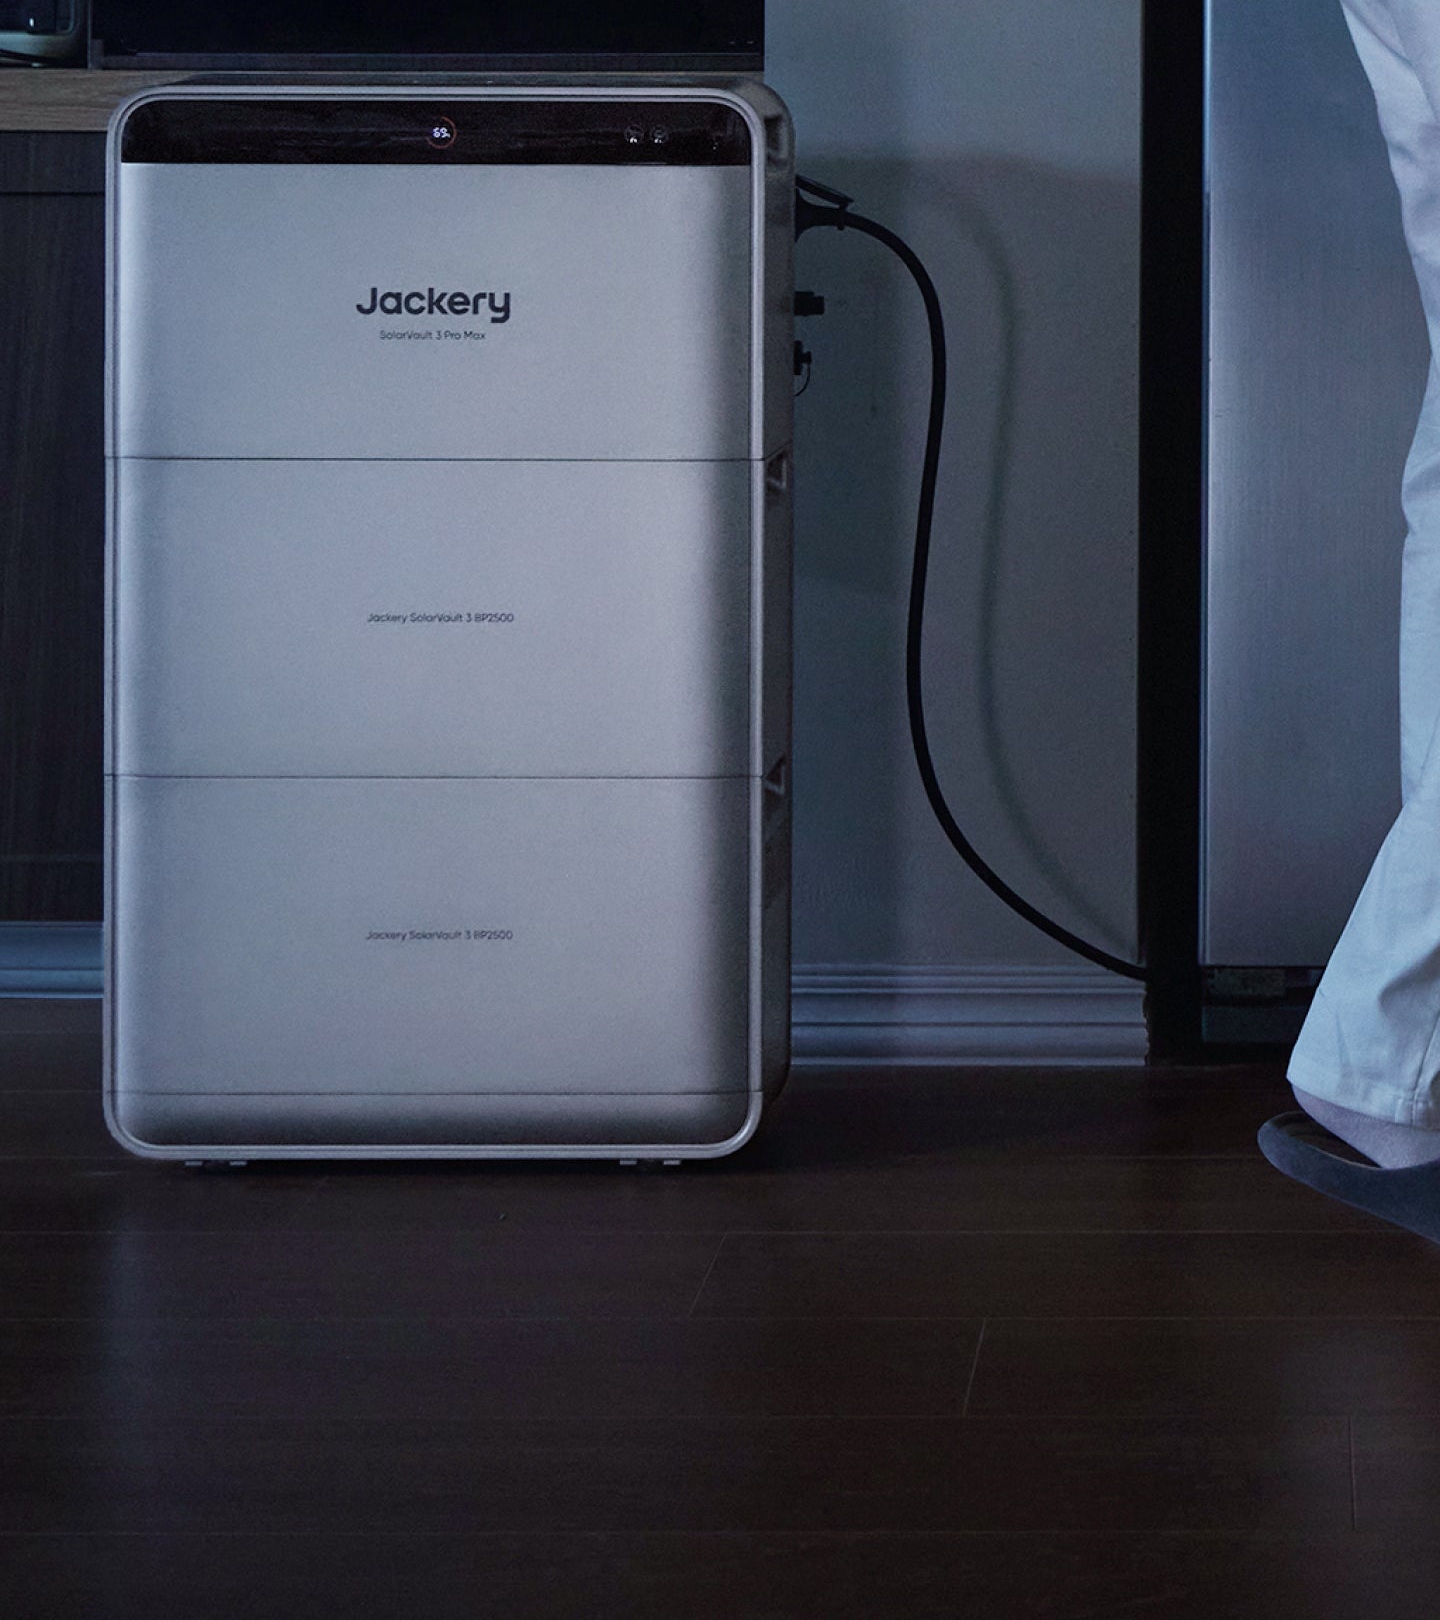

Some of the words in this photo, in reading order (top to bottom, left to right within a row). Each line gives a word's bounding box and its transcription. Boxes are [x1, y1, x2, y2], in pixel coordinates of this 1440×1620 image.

[356, 287, 511, 323] Jackery
[379, 330, 433, 340] SolarVault
[436, 330, 441, 340] 3
[444, 330, 461, 340] Pro
[464, 330, 485, 340] Max
[367, 613, 407, 624] Jackery
[410, 612, 463, 623] SolarVault
[466, 612, 472, 622] 3
[366, 931, 407, 941] Jackery
[465, 930, 471, 940] 3
